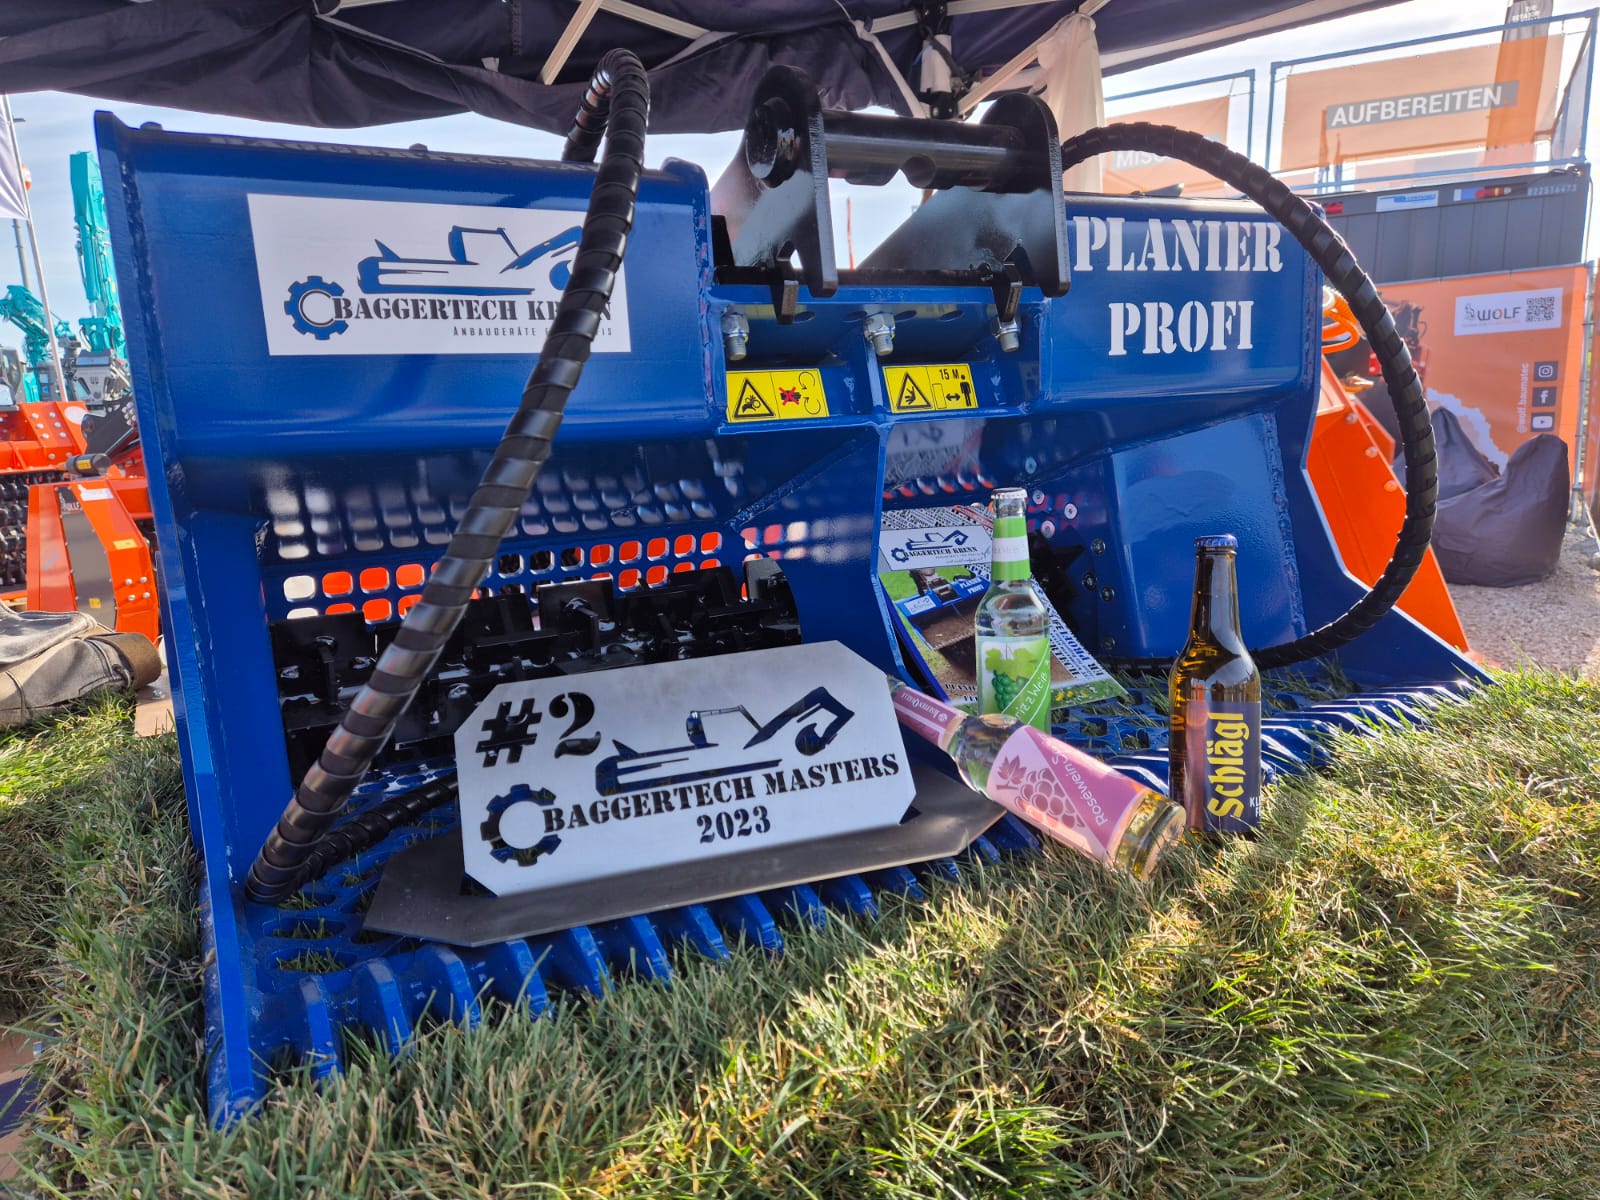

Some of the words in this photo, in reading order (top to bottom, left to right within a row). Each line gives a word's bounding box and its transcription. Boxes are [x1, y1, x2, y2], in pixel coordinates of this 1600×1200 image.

[1073, 216, 1283, 272] PLANIER
[334, 297, 518, 320] BAGGERTECH
[1108, 300, 1254, 356] PROFI
[1477, 307, 1521, 321] WOLF
[939, 369, 949, 380] 15
[475, 692, 601, 768] #2
[543, 771, 756, 833] BAGGERTECH
[766, 753, 899, 797] MASTERS
[1064, 759, 1108, 827] Roséwein
[1207, 713, 1250, 817] Schlägl
[697, 805, 771, 843] 2023
